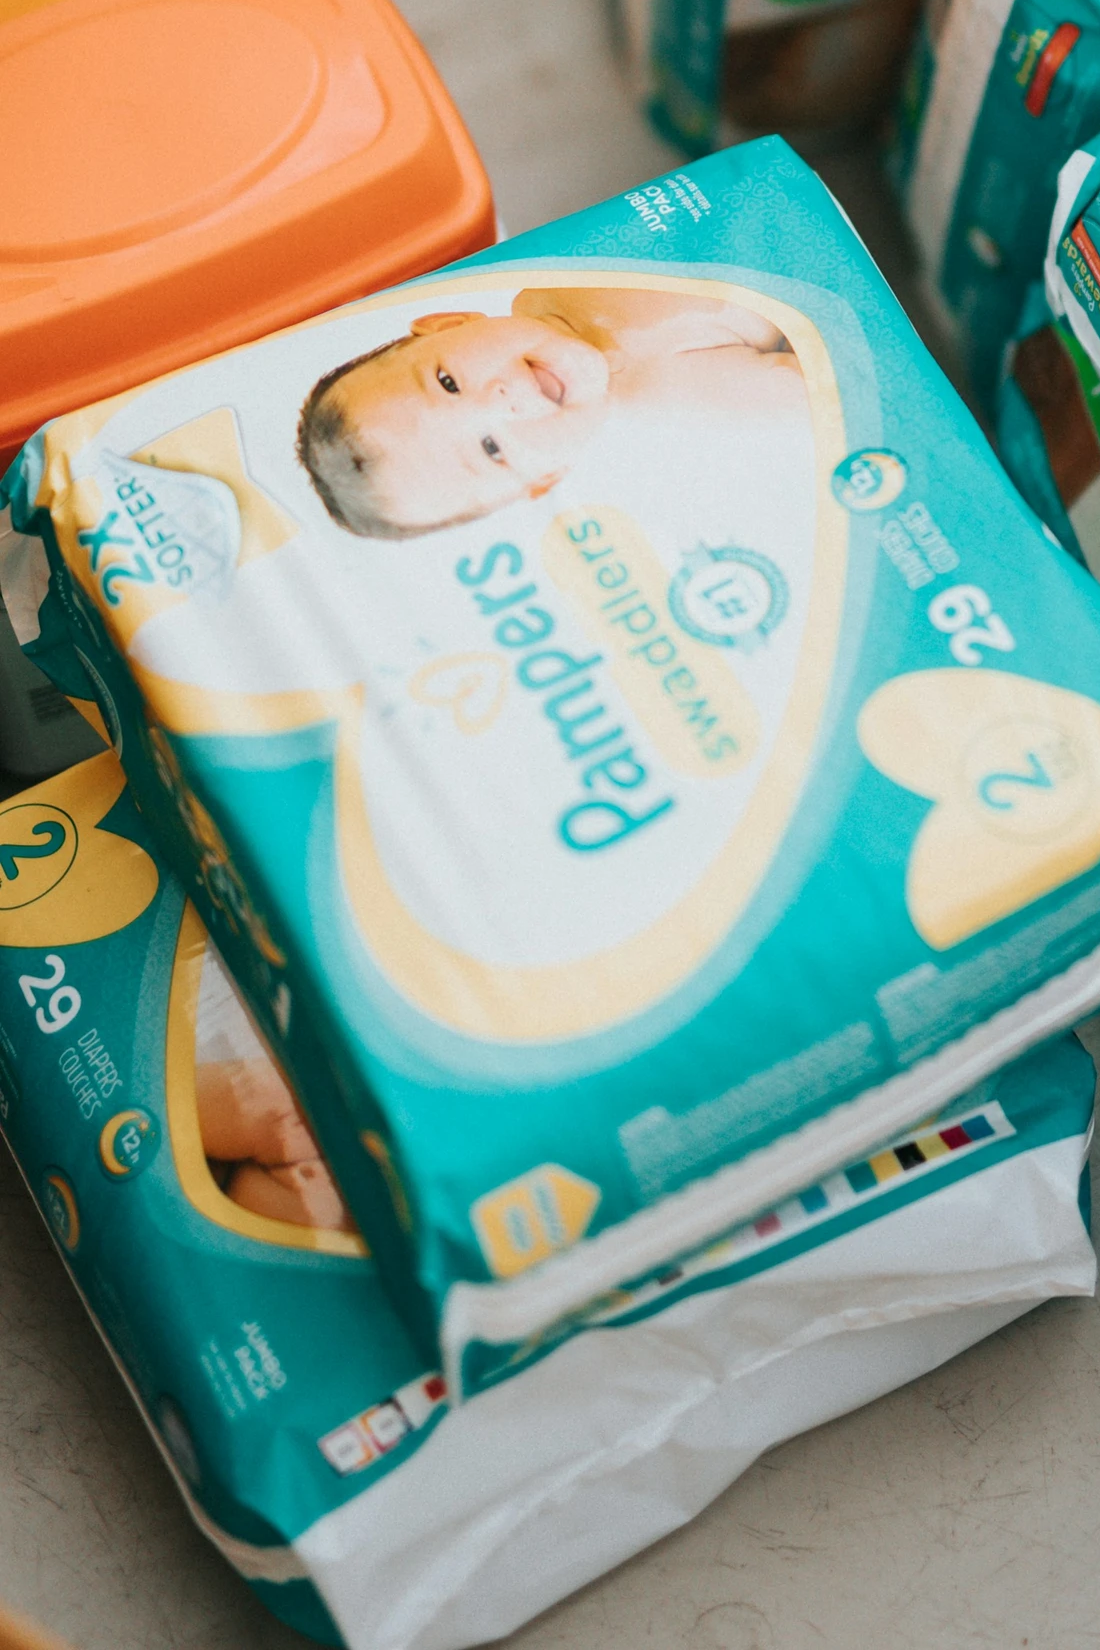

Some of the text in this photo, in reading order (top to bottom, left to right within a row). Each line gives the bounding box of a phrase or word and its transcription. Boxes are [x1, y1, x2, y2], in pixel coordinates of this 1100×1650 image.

[623, 185, 667, 240] JUMBO
[76, 510, 157, 608] 2X
[568, 520, 739, 759] swaddlers
[926, 583, 1017, 668] 29
[456, 541, 675, 853] Pampers
[977, 750, 1053, 812] 2
[0, 821, 66, 881] 2
[18, 955, 83, 1035] 29
[53, 1046, 105, 1120] COUCHES
[74, 1027, 126, 1098] DIAPERS
